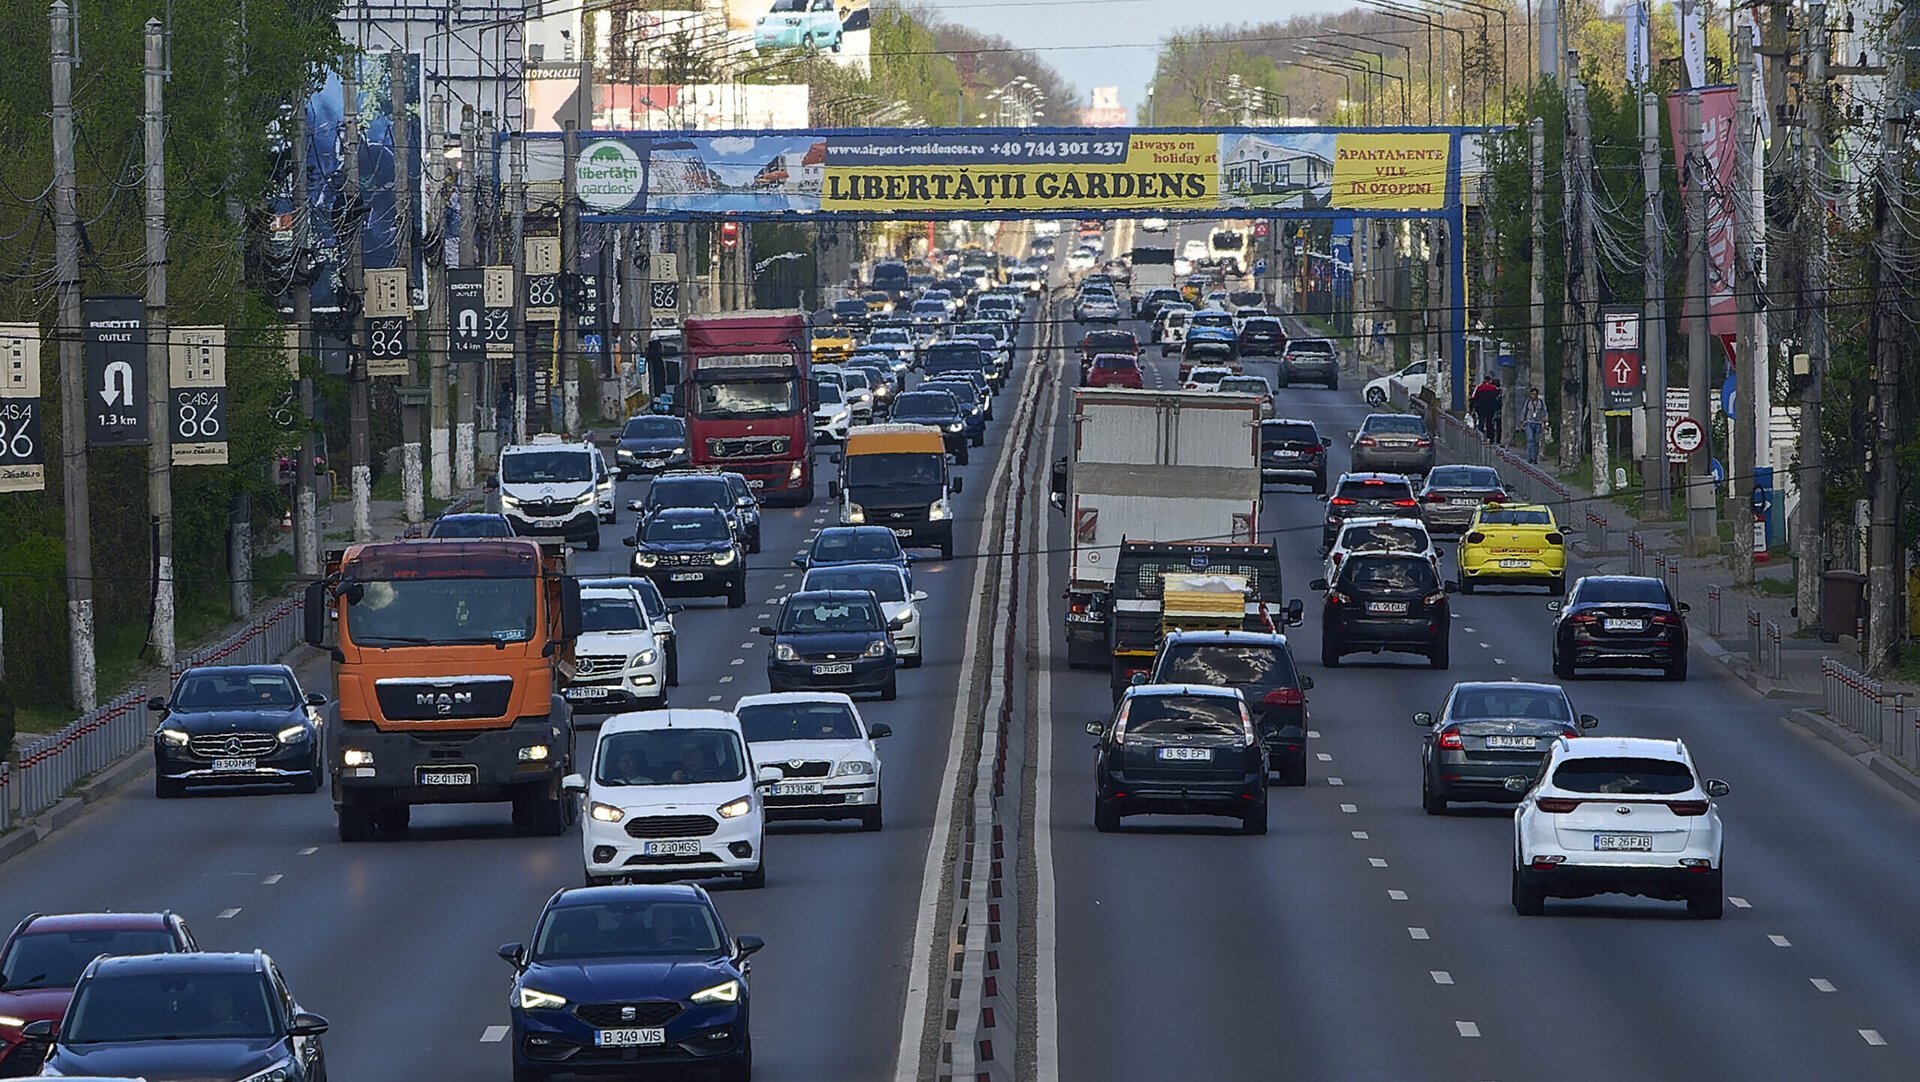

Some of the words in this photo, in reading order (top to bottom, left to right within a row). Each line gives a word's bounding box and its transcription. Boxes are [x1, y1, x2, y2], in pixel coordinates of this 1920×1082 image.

[827, 142, 985, 156] www.airport-residences.ro
[990, 142, 1021, 156] +40
[1024, 142, 1056, 157] 744
[1059, 142, 1089, 156] 301
[1093, 141, 1124, 157] 237
[1132, 140, 1175, 152] always
[1178, 142, 1195, 151] on
[1153, 152, 1201, 166] holiday
[1204, 153, 1218, 163] at
[1339, 149, 1444, 160] APARTAMENTE
[1375, 166, 1407, 177] VILE
[581, 181, 634, 198] gardens
[828, 168, 1026, 204] LIBERTĂȚII
[1035, 173, 1206, 199] GARDENS
[1370, 183, 1432, 195] OTOPENI
[529, 281, 555, 305] 86
[98, 334, 132, 342] OUTLET
[371, 330, 402, 356] 86
[178, 393, 219, 405] CASA
[0, 404, 32, 420] ASA
[98, 415, 117, 426] 1.3
[120, 415, 137, 426] km
[179, 404, 219, 437] 86
[416, 692, 472, 705] MAN
[1491, 738, 1497, 746] B
[1167, 750, 1173, 758] B
[454, 774, 468, 783] TRT
[785, 785, 801, 794] 333
[651, 843, 658, 854] B
[661, 843, 678, 853] 230
[1600, 838, 1614, 847] GR
[1618, 838, 1630, 847] 26
[1630, 838, 1650, 847] FAB
[604, 1032, 612, 1043] B
[617, 1030, 638, 1042] 349
[642, 1029, 661, 1041] VIS
